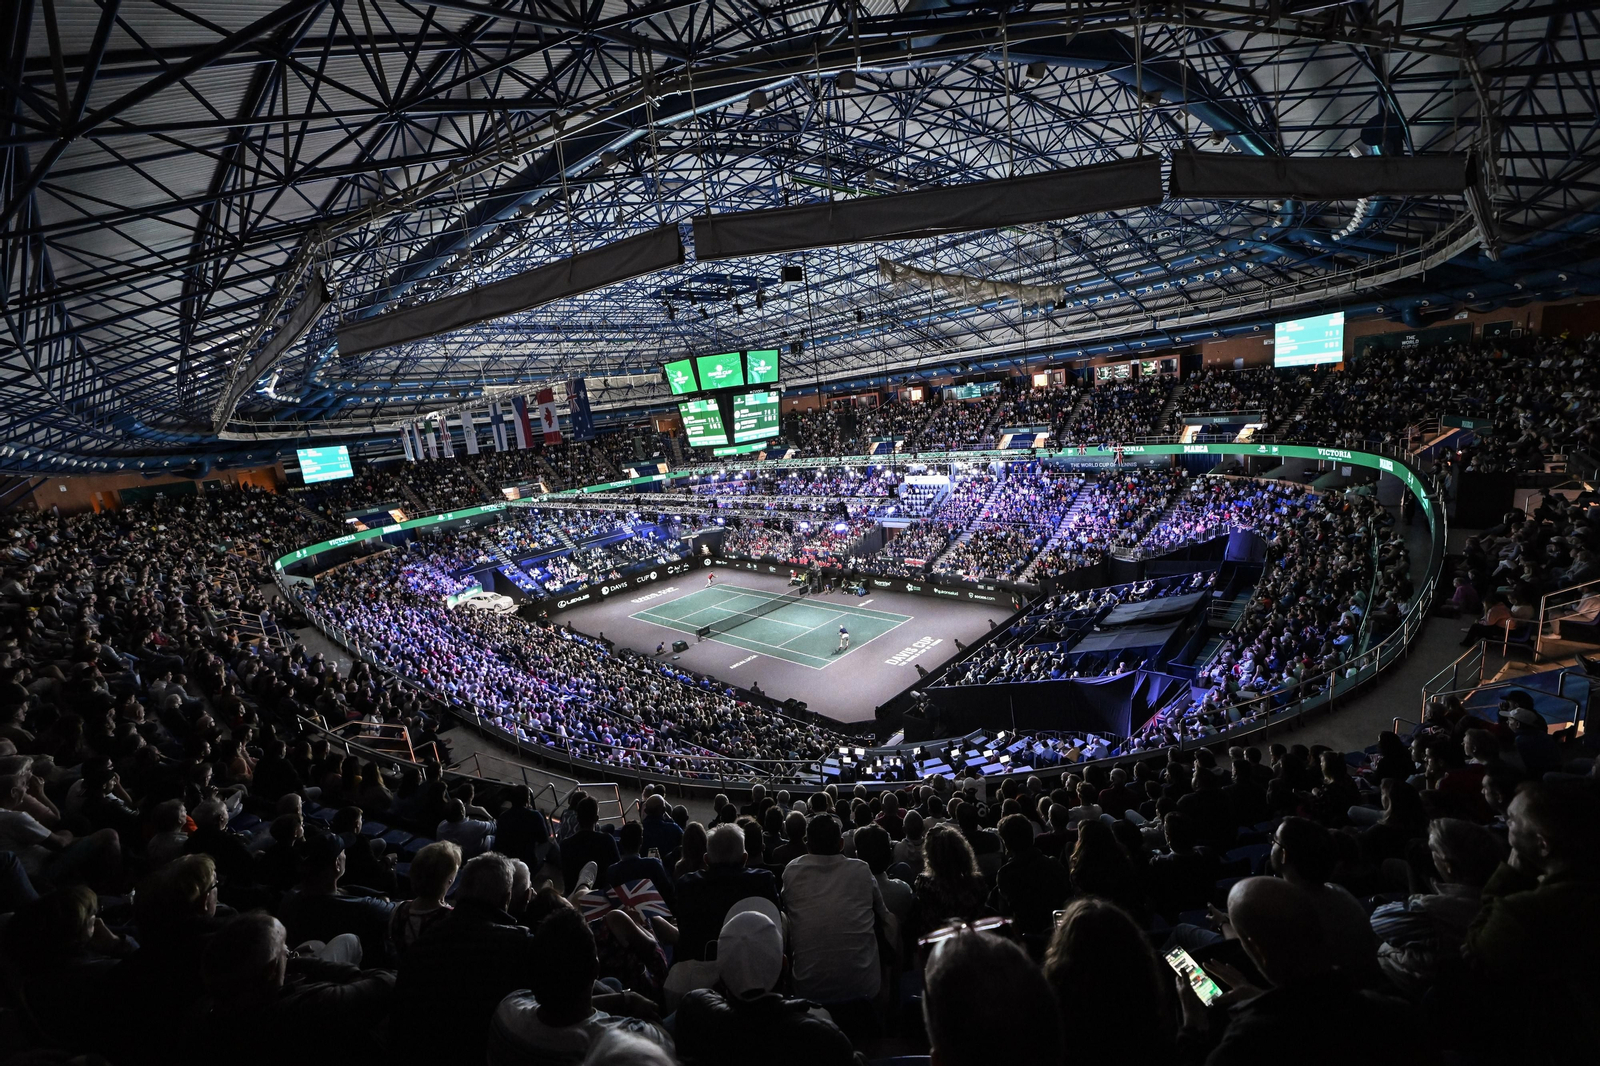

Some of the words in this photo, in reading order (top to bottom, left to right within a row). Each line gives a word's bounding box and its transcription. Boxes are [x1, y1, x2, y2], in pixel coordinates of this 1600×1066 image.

[1318, 448, 1352, 458] VICTORIA
[328, 534, 356, 546] VICTORIA
[610, 582, 628, 592] DAVIS
[637, 575, 650, 583] CUP
[884, 647, 918, 665] DAVIS
[912, 636, 934, 648] CUP
